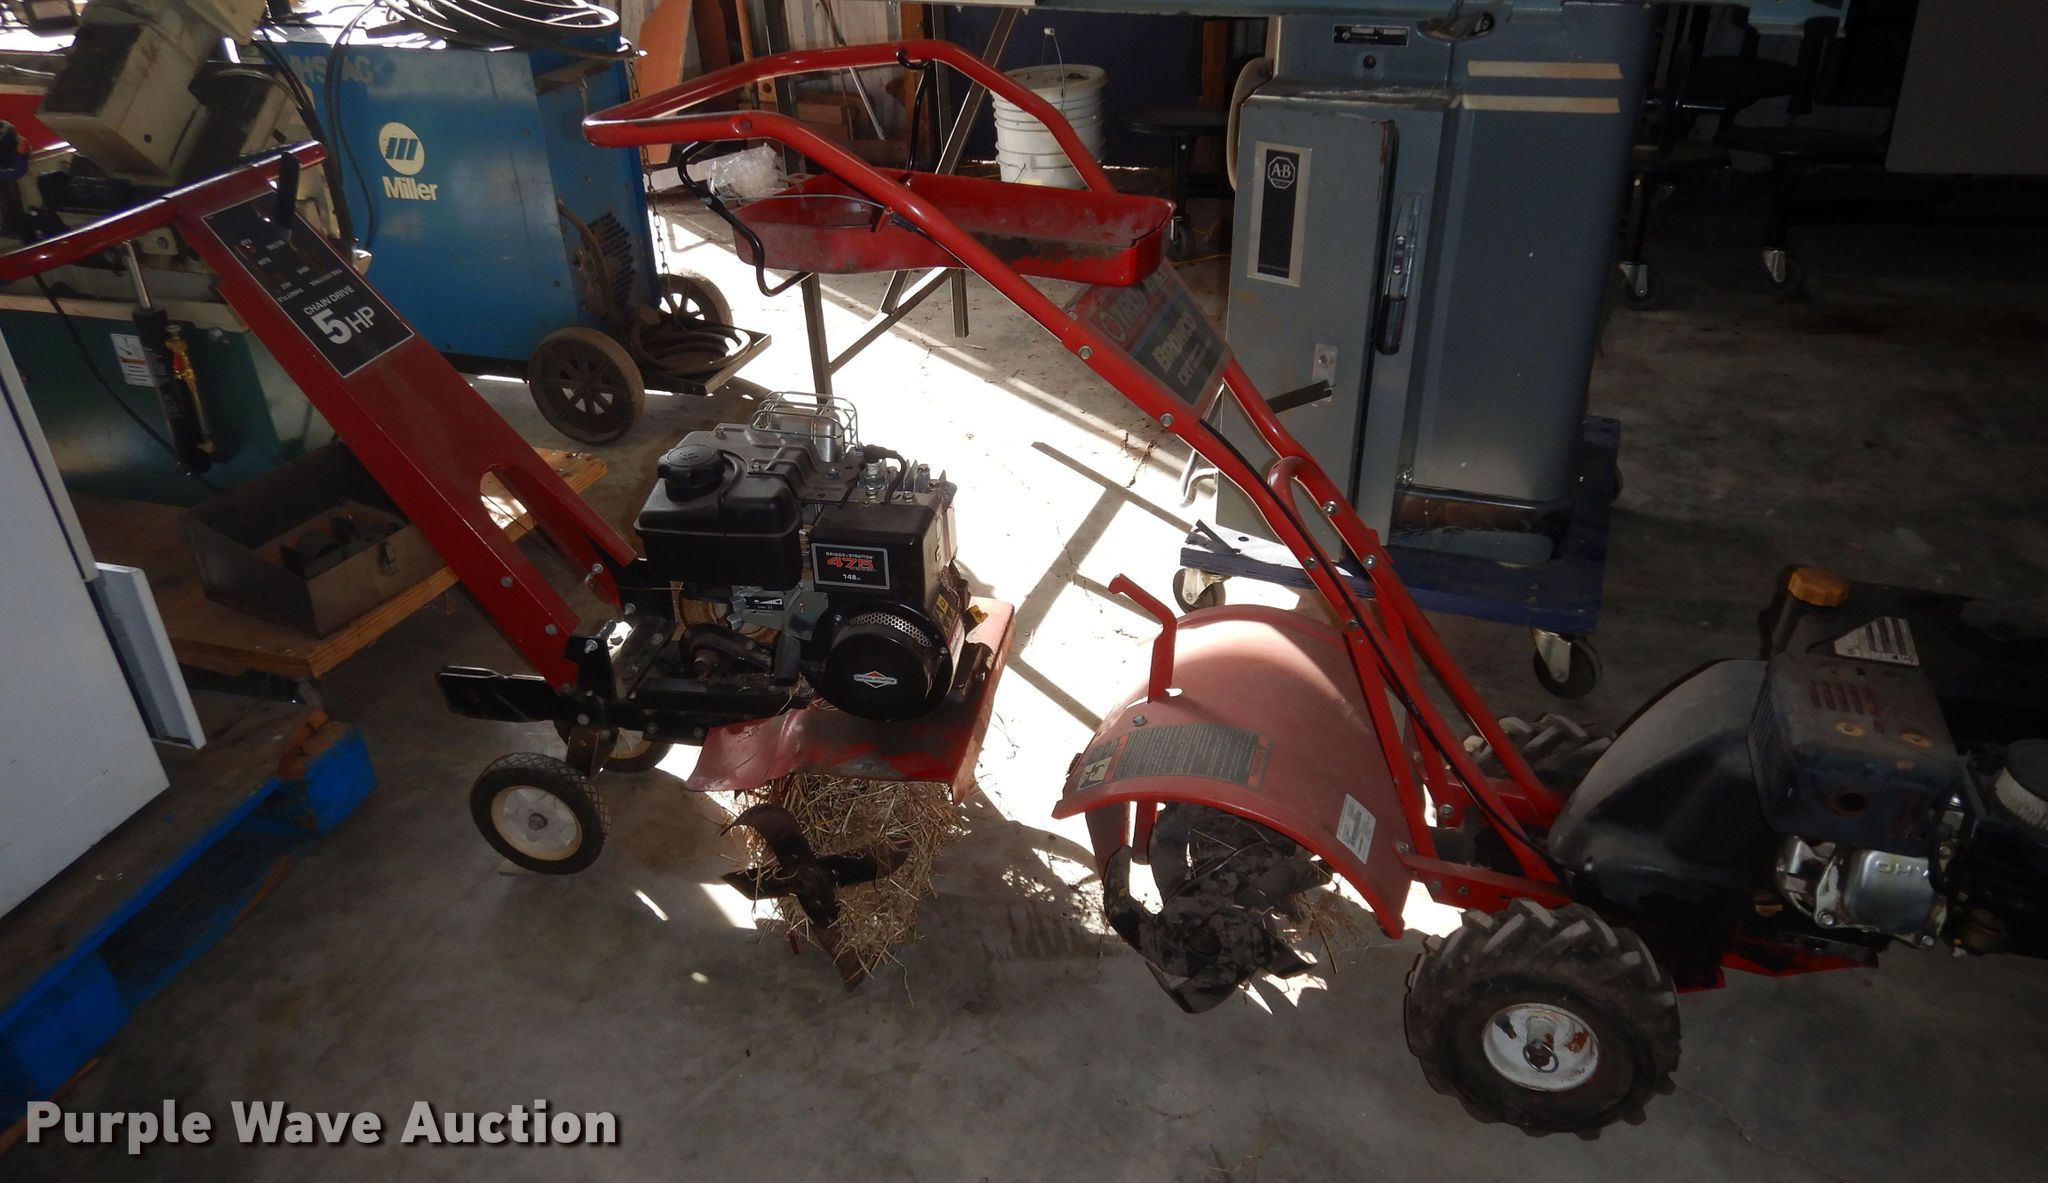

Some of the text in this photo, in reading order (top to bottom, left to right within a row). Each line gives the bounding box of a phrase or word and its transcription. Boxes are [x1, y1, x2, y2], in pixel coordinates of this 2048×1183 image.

[382, 175, 438, 201] Miller
[303, 285, 355, 316] CHAIN DRIVE
[311, 308, 352, 345] 5
[827, 556, 874, 572] 475
